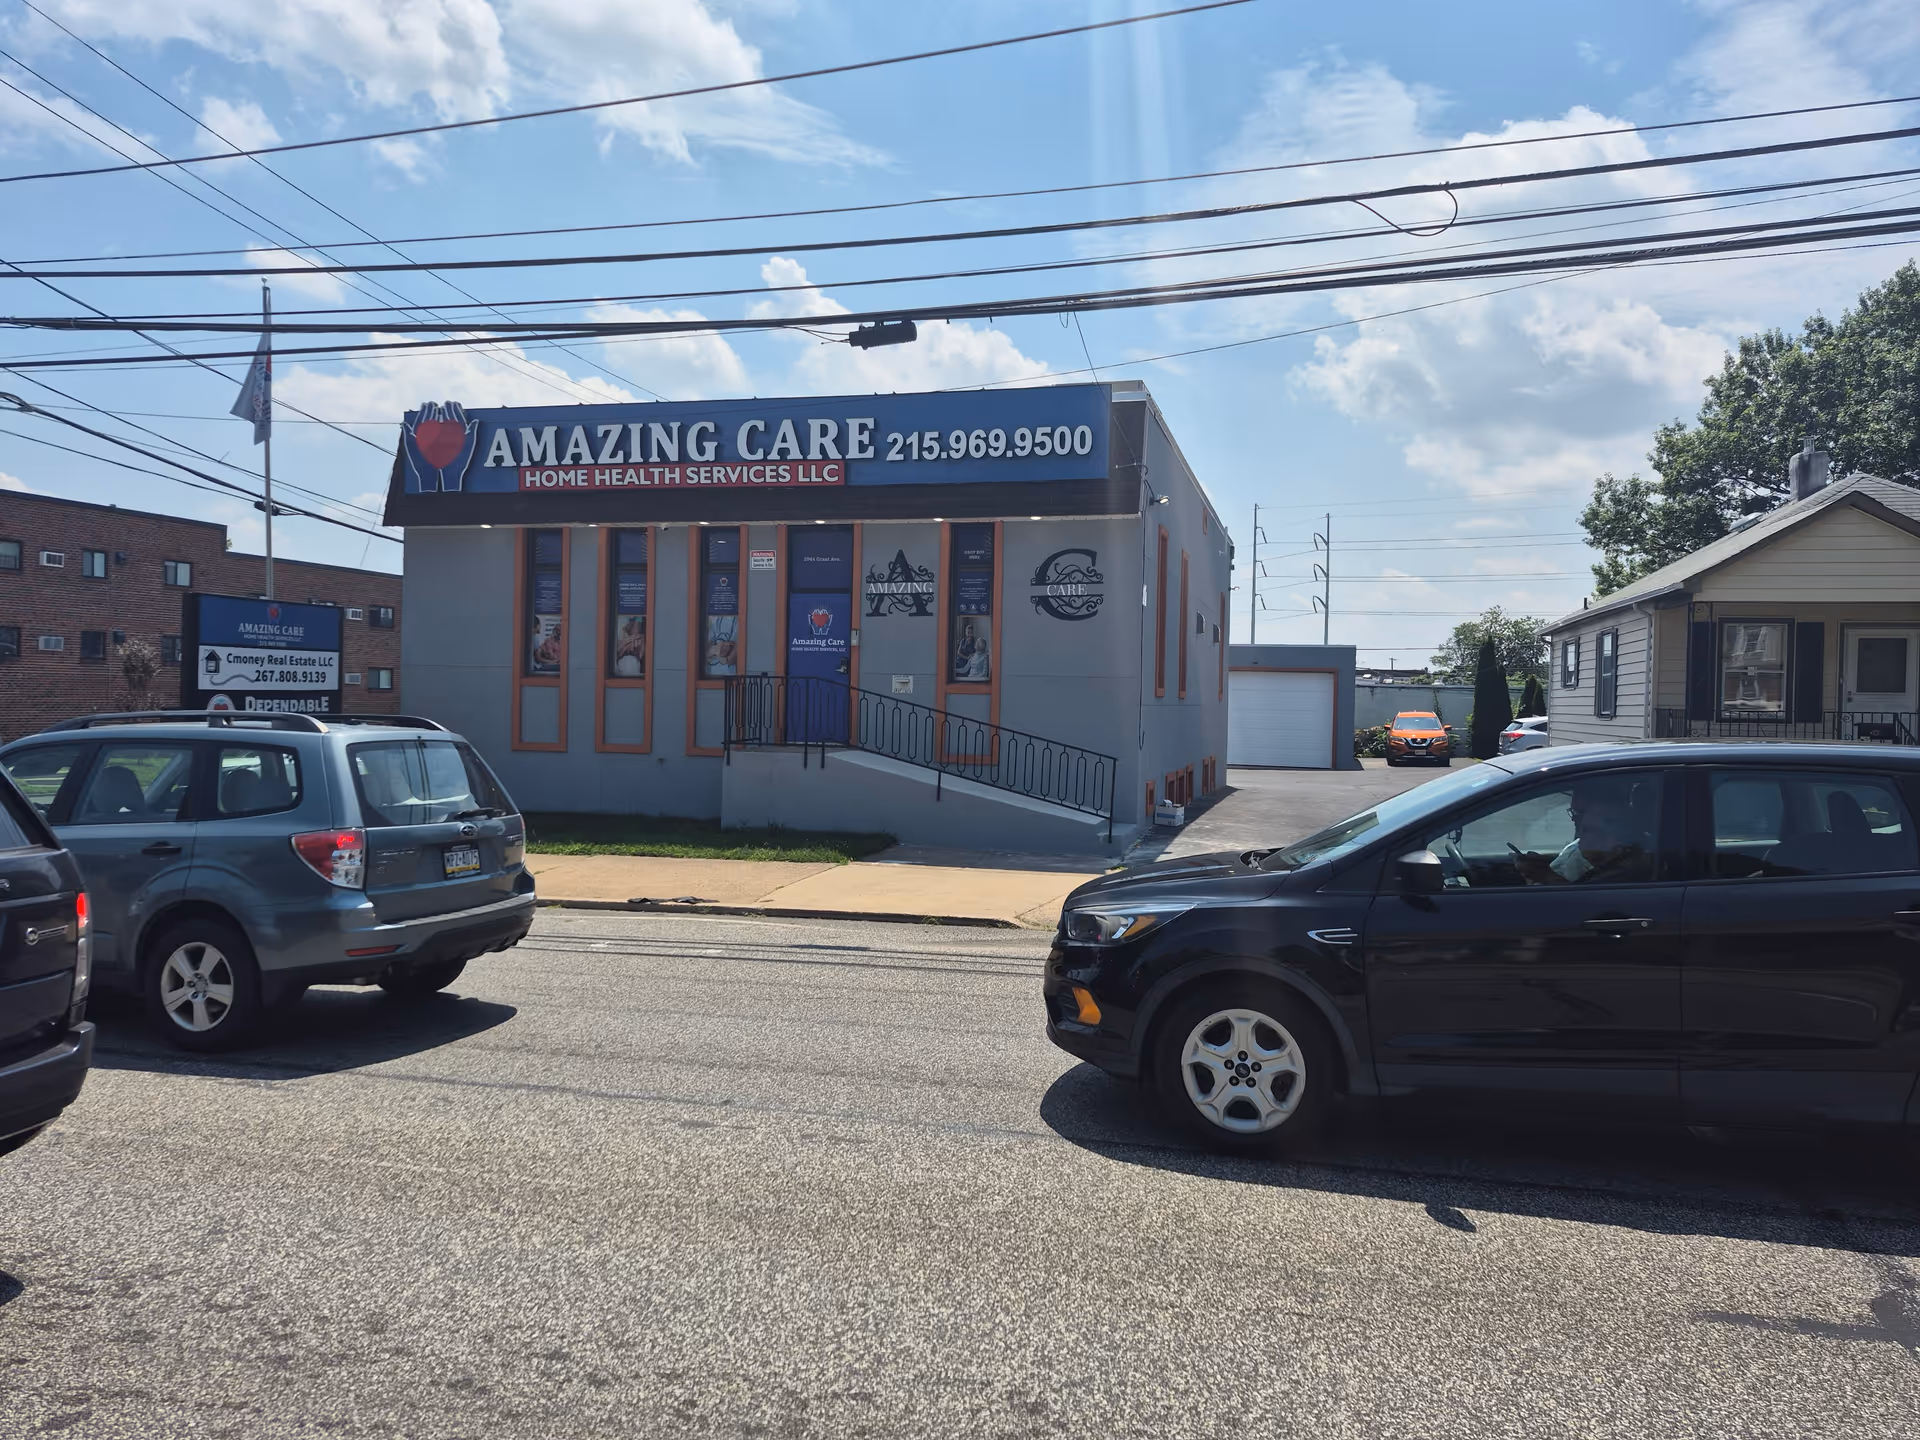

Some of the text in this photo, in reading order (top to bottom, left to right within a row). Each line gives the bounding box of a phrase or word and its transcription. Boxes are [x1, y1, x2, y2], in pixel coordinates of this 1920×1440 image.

[483, 417, 875, 468] AMAZING CARE
[886, 425, 1093, 461] 215.969.9500
[525, 463, 840, 487] HOME HEALTH SERVICES LLC
[867, 582, 933, 594] AMAZING
[1046, 583, 1088, 596] CARE
[238, 623, 304, 636] AMAZING CARE
[792, 637, 845, 647] Amazing Care
[226, 653, 334, 667] Cmoney Real Estate LLC
[255, 670, 326, 683] 267.808.9139
